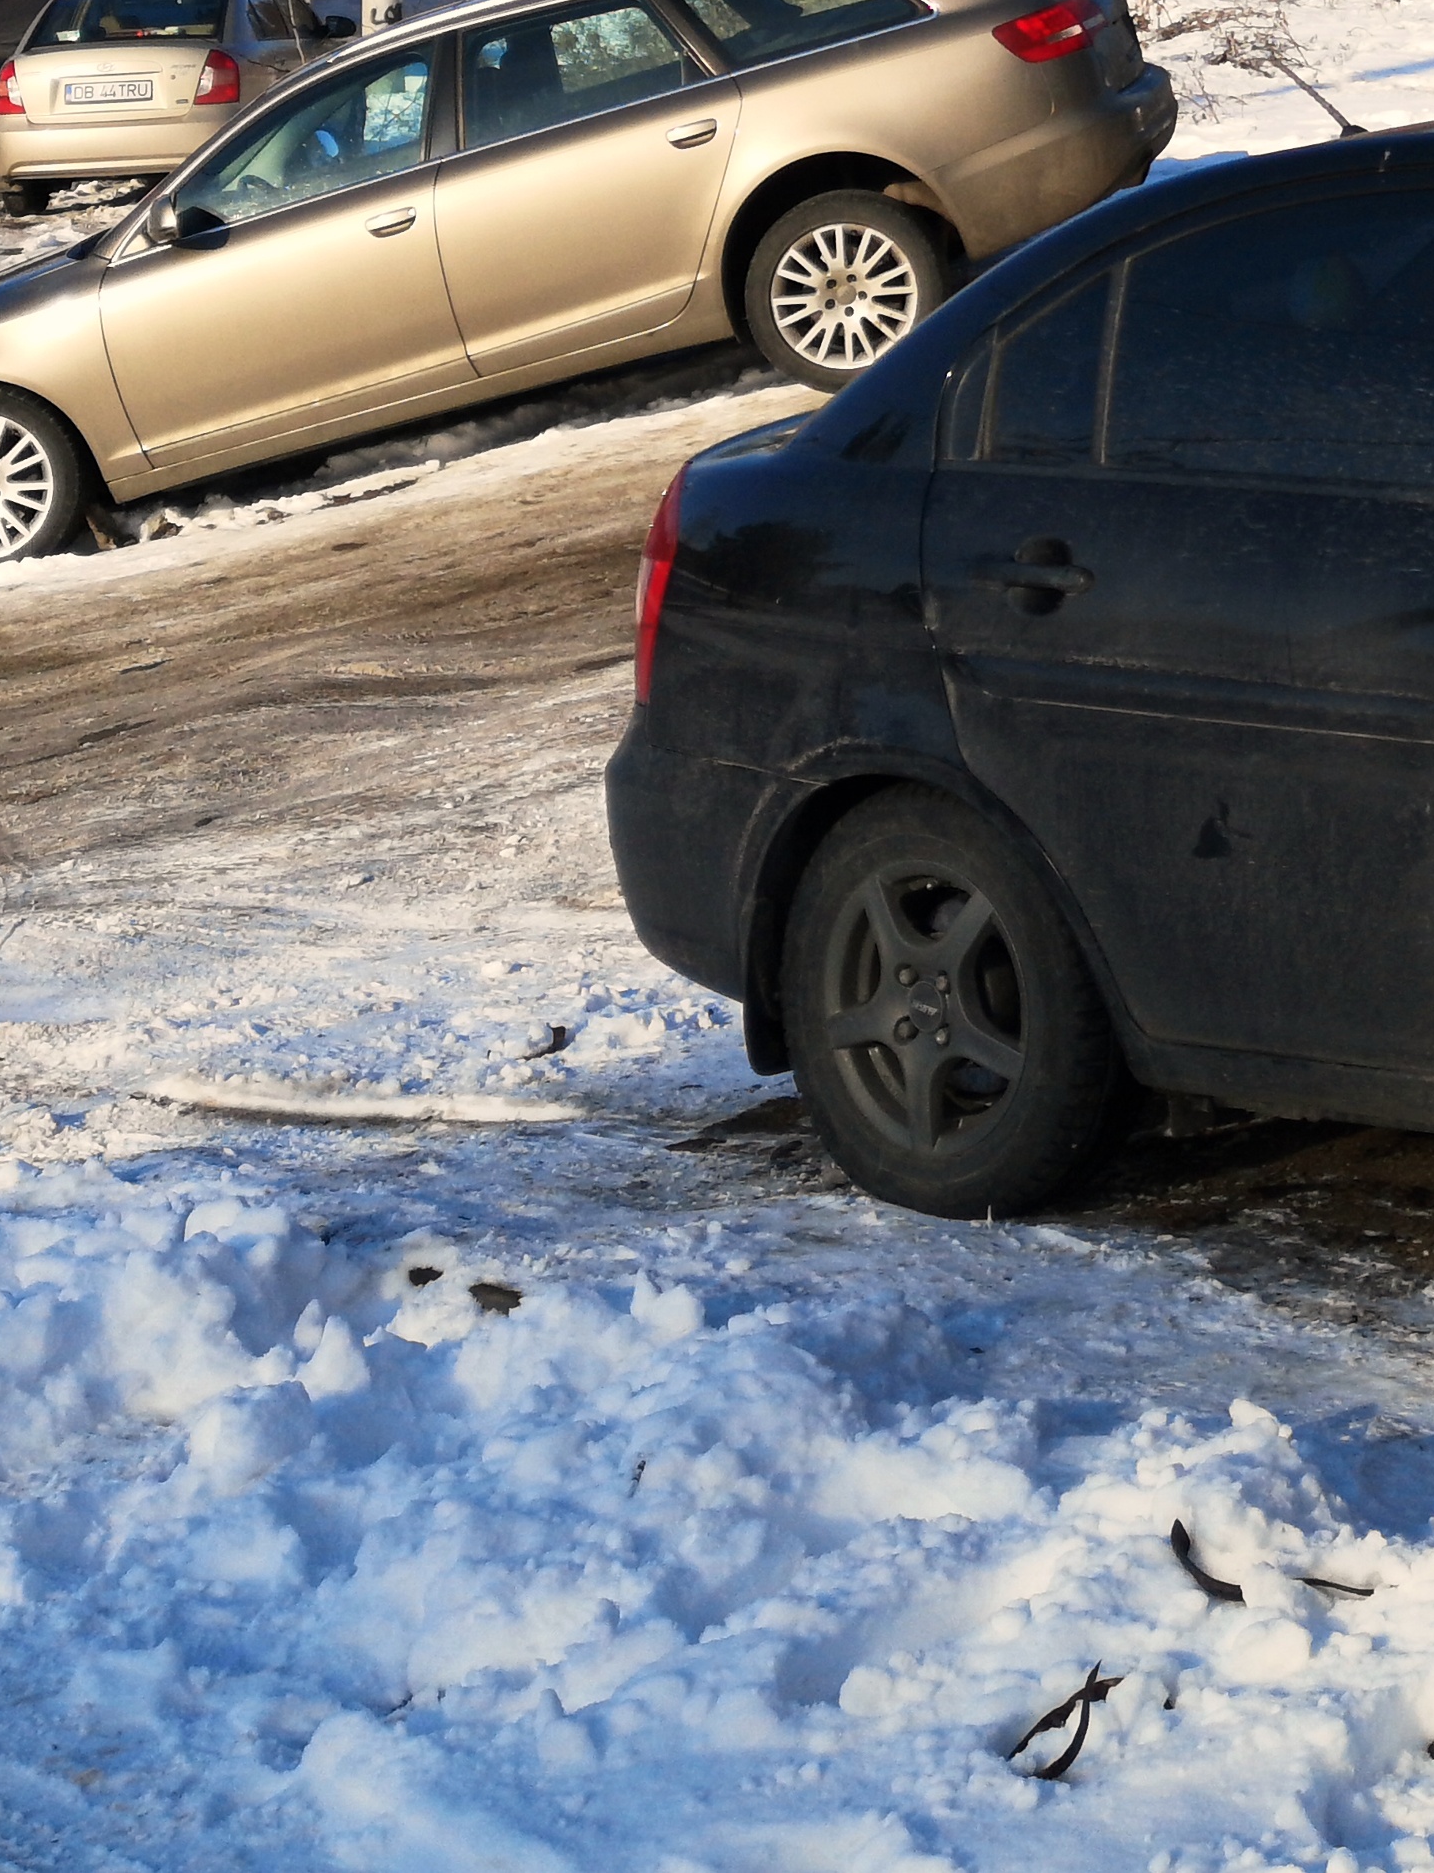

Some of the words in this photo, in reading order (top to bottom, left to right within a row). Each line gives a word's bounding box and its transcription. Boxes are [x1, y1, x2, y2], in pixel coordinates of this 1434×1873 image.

[73, 85, 94, 100] DB
[99, 84, 117, 98] 44
[118, 82, 148, 98] TRU
